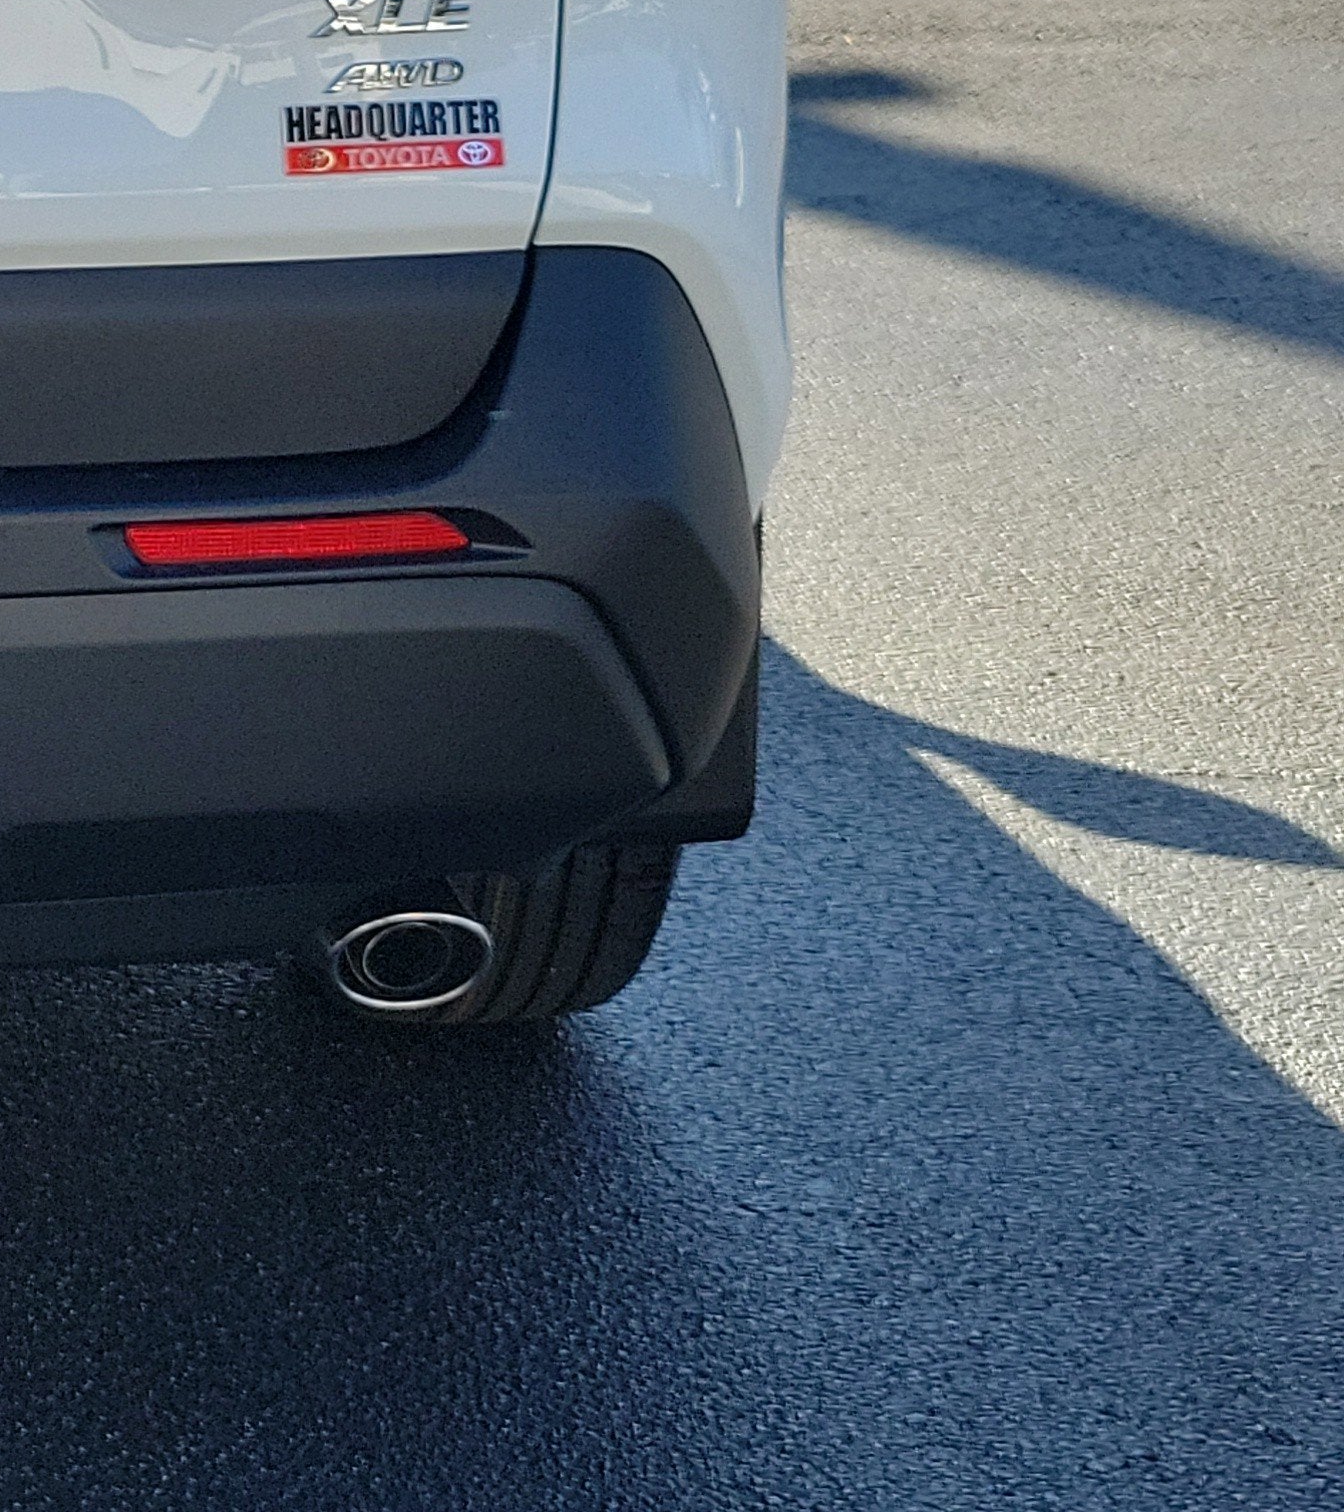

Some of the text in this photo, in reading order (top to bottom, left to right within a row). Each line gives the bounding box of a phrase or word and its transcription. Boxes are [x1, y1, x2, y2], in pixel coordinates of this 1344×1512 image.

[322, 57, 465, 94] AWD
[284, 99, 501, 142] HEADQUARTER
[343, 144, 451, 170] TOYOTA
